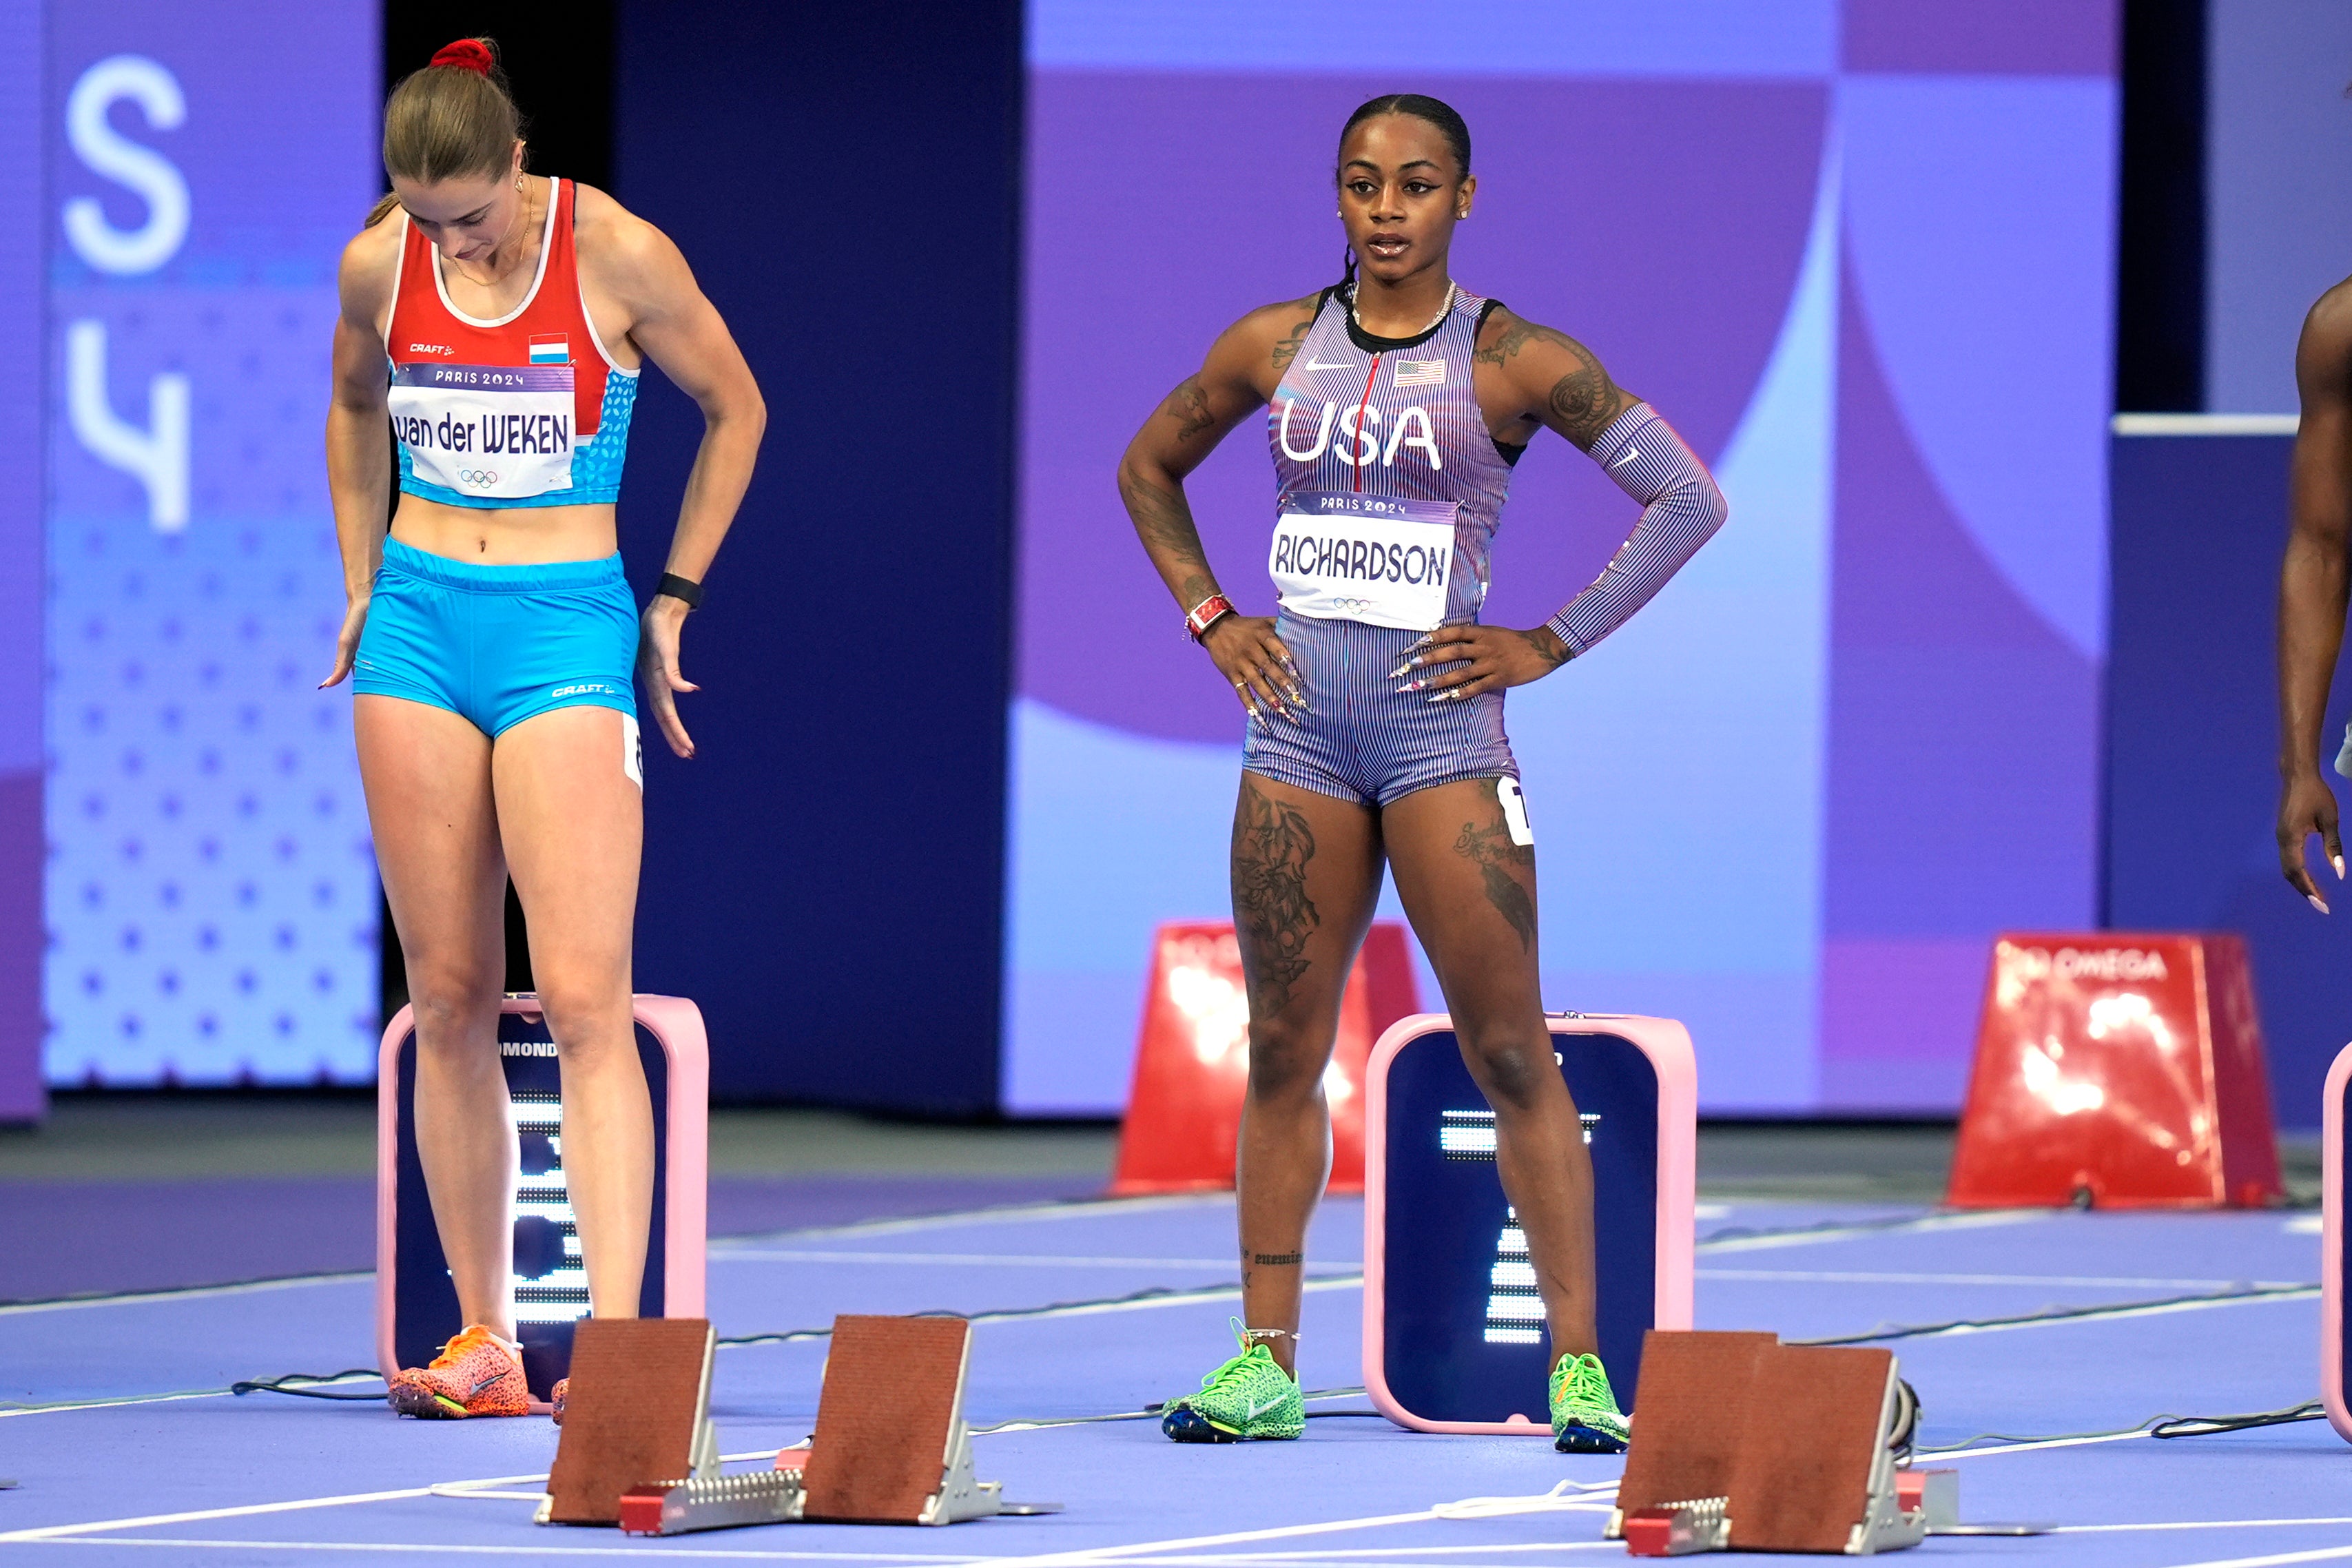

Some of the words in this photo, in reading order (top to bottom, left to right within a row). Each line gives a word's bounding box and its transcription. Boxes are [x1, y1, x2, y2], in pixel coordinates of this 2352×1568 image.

[63, 54, 191, 275] S
[409, 343, 444, 354] CRAFT
[435, 370, 477, 384] PARIS
[482, 373, 524, 386] 2024
[67, 318, 190, 535] 4
[395, 415, 433, 448] van
[437, 412, 475, 453] der
[483, 414, 568, 454] WEKEN
[1280, 398, 1442, 471] USA
[1321, 497, 1359, 510] PARIS
[1364, 499, 1405, 514] 2024
[1275, 534, 1446, 586] RICHARDSON
[551, 683, 604, 698] CRAFT
[2052, 946, 2169, 982] OMEGA
[502, 1042, 559, 1058] MOND
